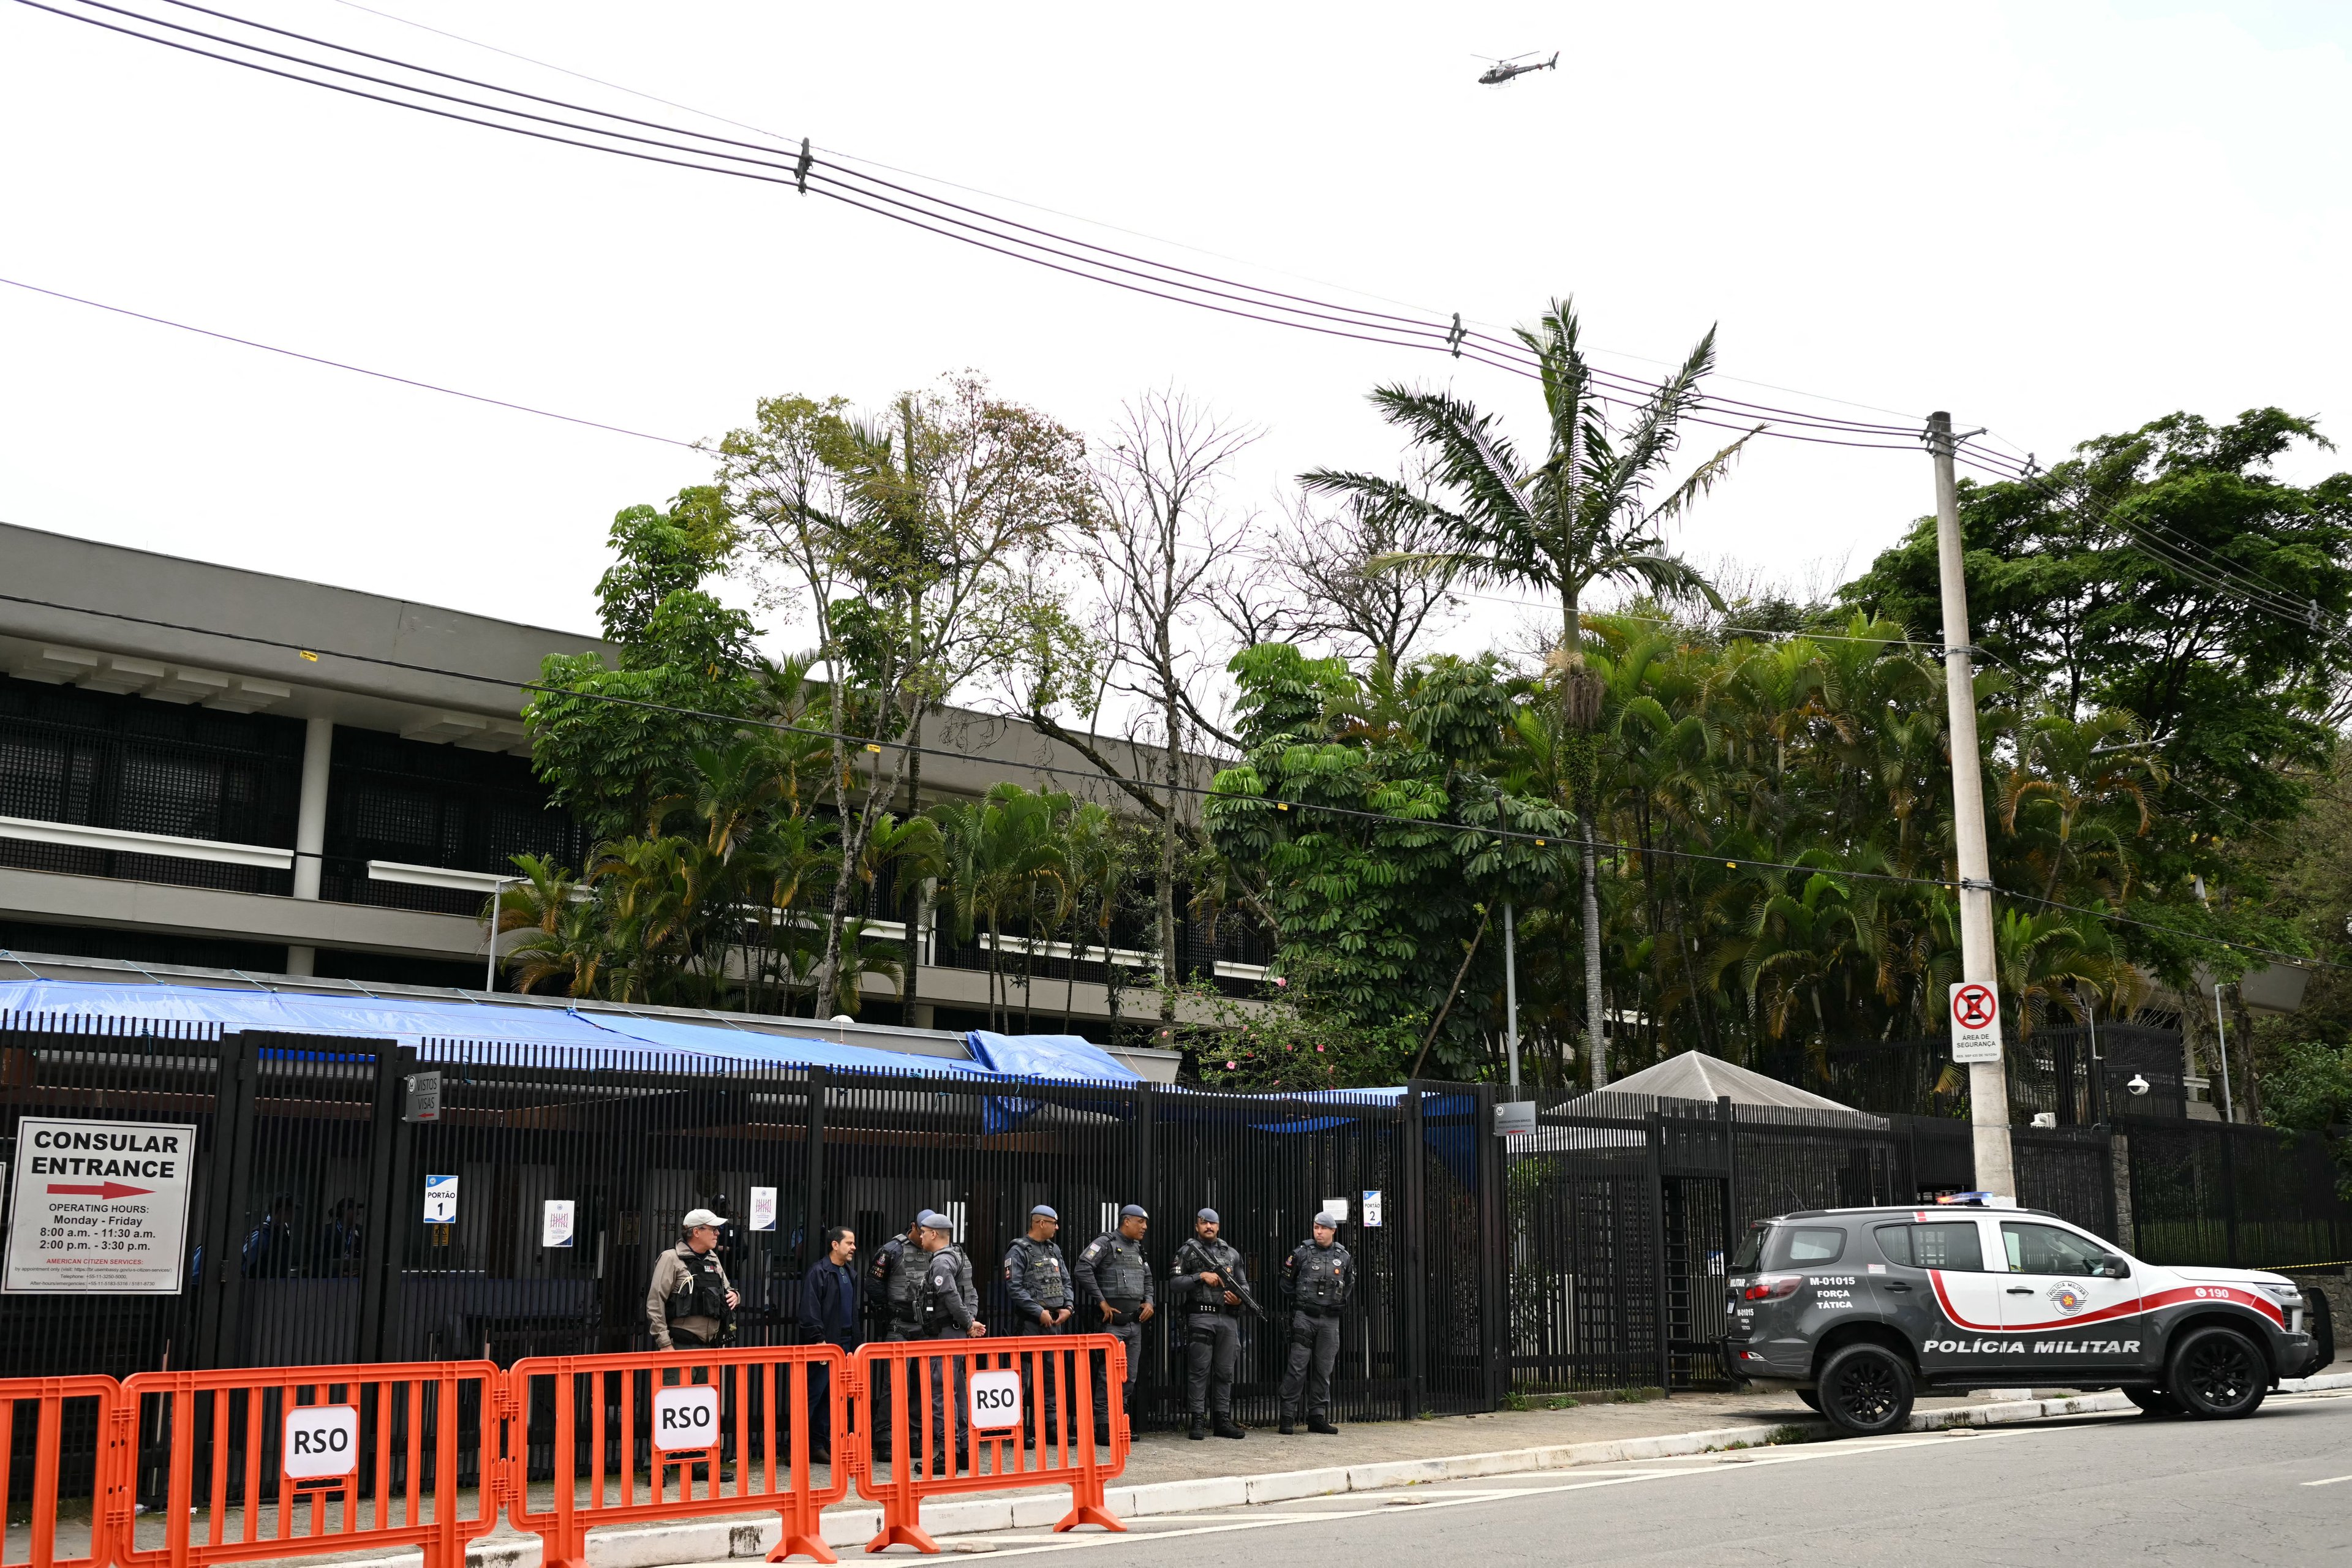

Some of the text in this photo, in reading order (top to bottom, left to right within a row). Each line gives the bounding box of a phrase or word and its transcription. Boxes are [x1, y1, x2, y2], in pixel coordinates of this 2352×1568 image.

[417, 1078, 437, 1091] VISTOS
[418, 1097, 434, 1110] VISAS
[34, 1131, 178, 1153] CONSULAR
[31, 1156, 175, 1178] ENTRANCE
[49, 1204, 149, 1213] OPERATING HOURS:
[437, 1202, 443, 1216] 1
[54, 1215, 98, 1226] Monday
[108, 1216, 143, 1227] Friday
[1370, 1211, 1375, 1221] 2
[40, 1227, 64, 1237] 8:00
[102, 1229, 130, 1238] 11:30
[40, 1240, 63, 1249] 2:00
[67, 1242, 90, 1251] p.m.
[101, 1241, 124, 1250] 3:30
[127, 1243, 150, 1252] p.m.
[1730, 1278, 1746, 1287] MILITAR
[1810, 1276, 1855, 1286] M-01015
[1817, 1290, 1850, 1298] FORÇA
[2068, 1283, 2086, 1295] MILITAR
[2207, 1288, 2229, 1298] 190
[1817, 1300, 1853, 1309] TÁTICA
[1923, 1338, 2140, 1353] POLÍCIA MILITAR
[977, 1388, 1014, 1409] RSO
[663, 1406, 710, 1430] RSO
[295, 1428, 348, 1455] RSO
